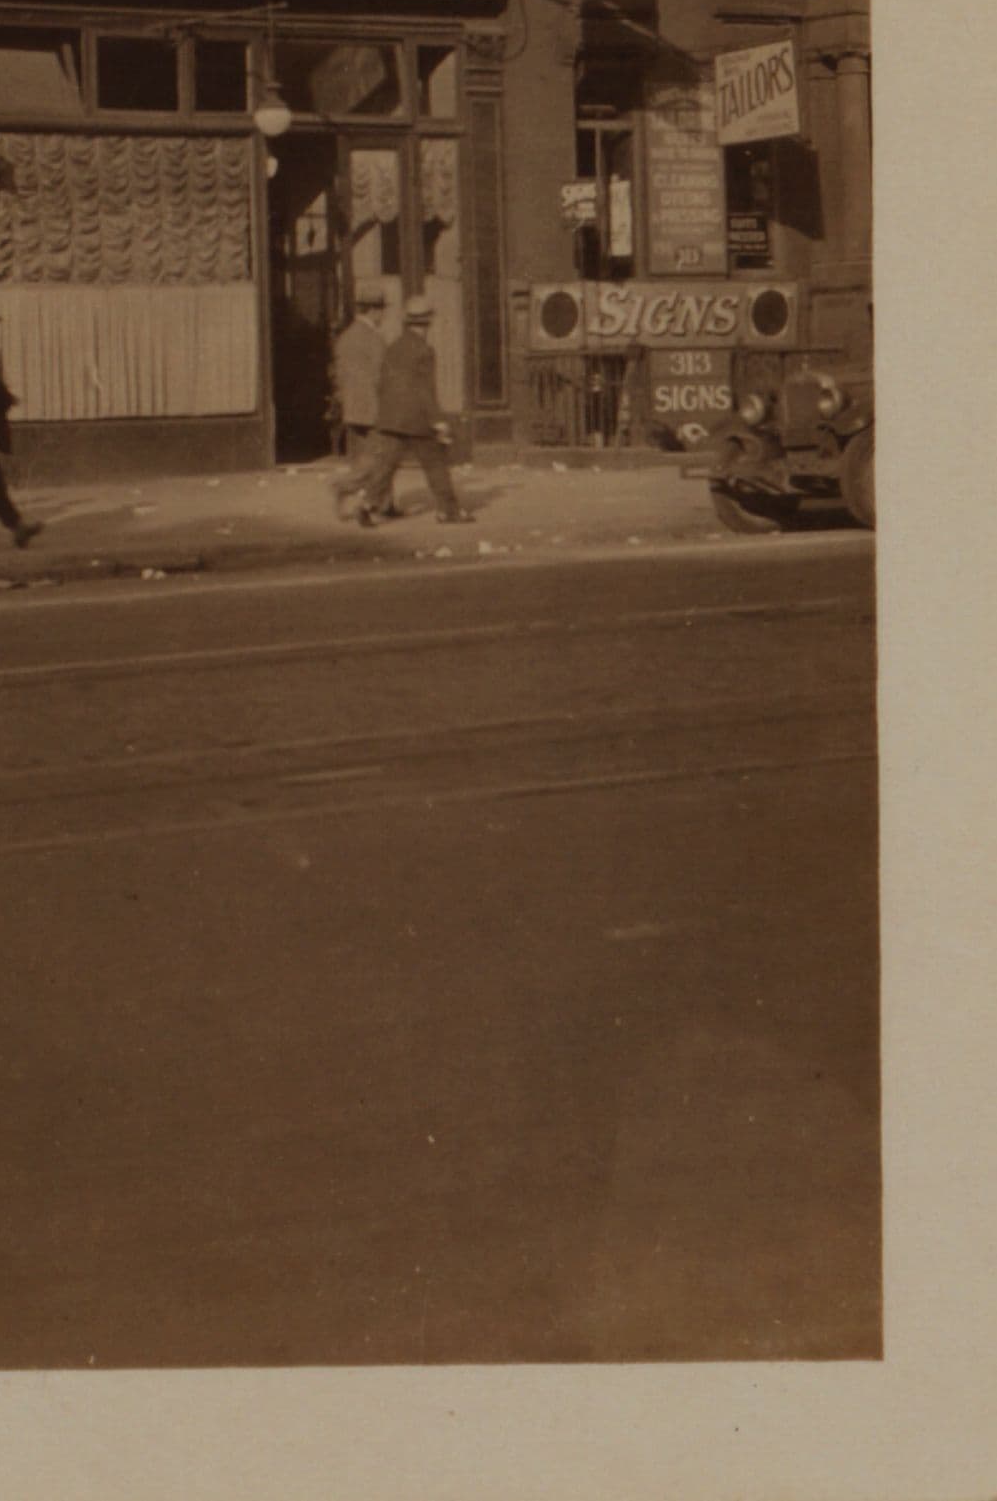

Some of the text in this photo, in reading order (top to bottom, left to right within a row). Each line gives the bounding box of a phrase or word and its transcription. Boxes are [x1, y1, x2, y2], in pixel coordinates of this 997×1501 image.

[720, 47, 793, 128] TAILORS
[588, 285, 739, 337] SIGNS
[669, 352, 712, 375] 313
[654, 385, 732, 412] SIGNS
